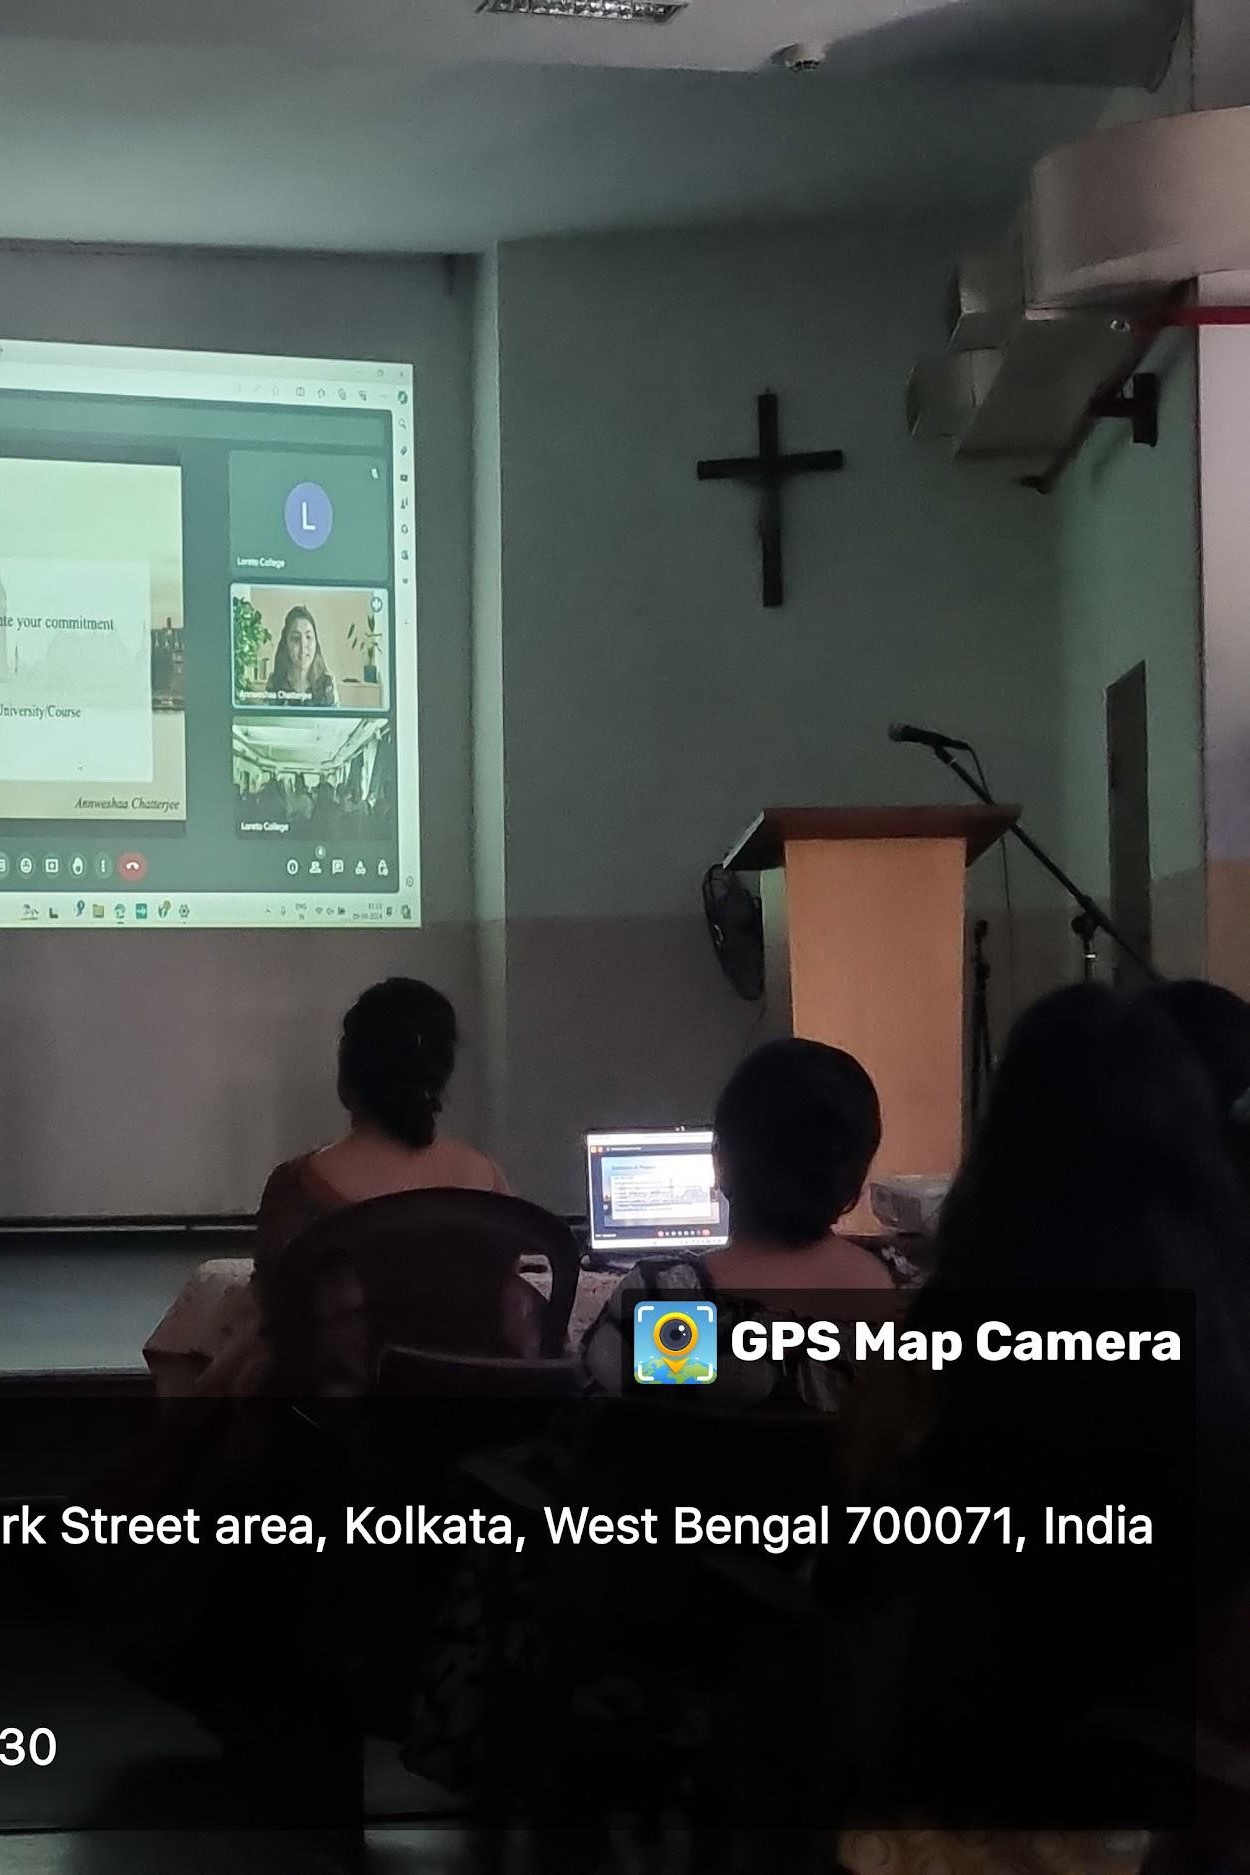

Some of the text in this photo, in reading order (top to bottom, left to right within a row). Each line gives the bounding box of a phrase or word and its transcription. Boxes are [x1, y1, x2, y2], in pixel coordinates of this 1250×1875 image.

[302, 501, 316, 530] L
[17, 617, 42, 631] your
[45, 615, 115, 631] commitment
[131, 797, 180, 813] Chatterjee
